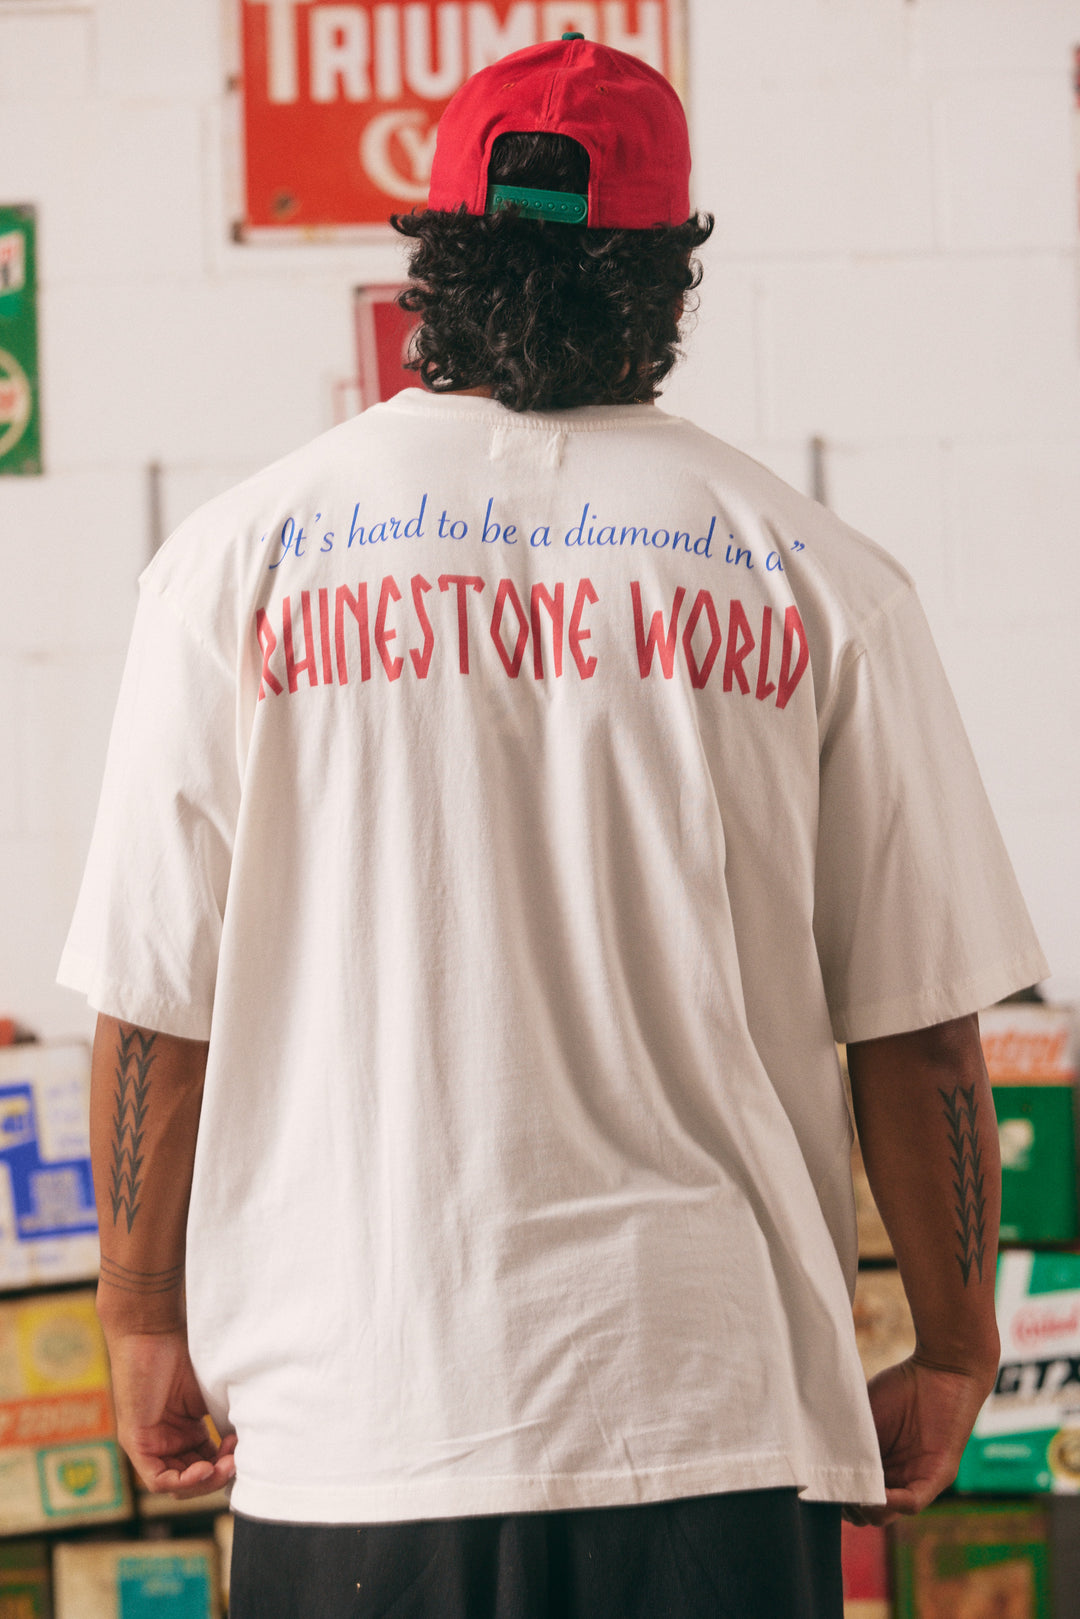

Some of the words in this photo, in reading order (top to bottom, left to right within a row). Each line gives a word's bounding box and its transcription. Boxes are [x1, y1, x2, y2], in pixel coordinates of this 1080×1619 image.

[347, 493, 428, 548] hard
[437, 510, 469, 539] to
[481, 497, 518, 545] be
[529, 526, 552, 548] a
[564, 502, 717, 559] diamond
[725, 533, 755, 570] in
[256, 573, 600, 702] RHINESTONE
[629, 580, 810, 710] WORLD
